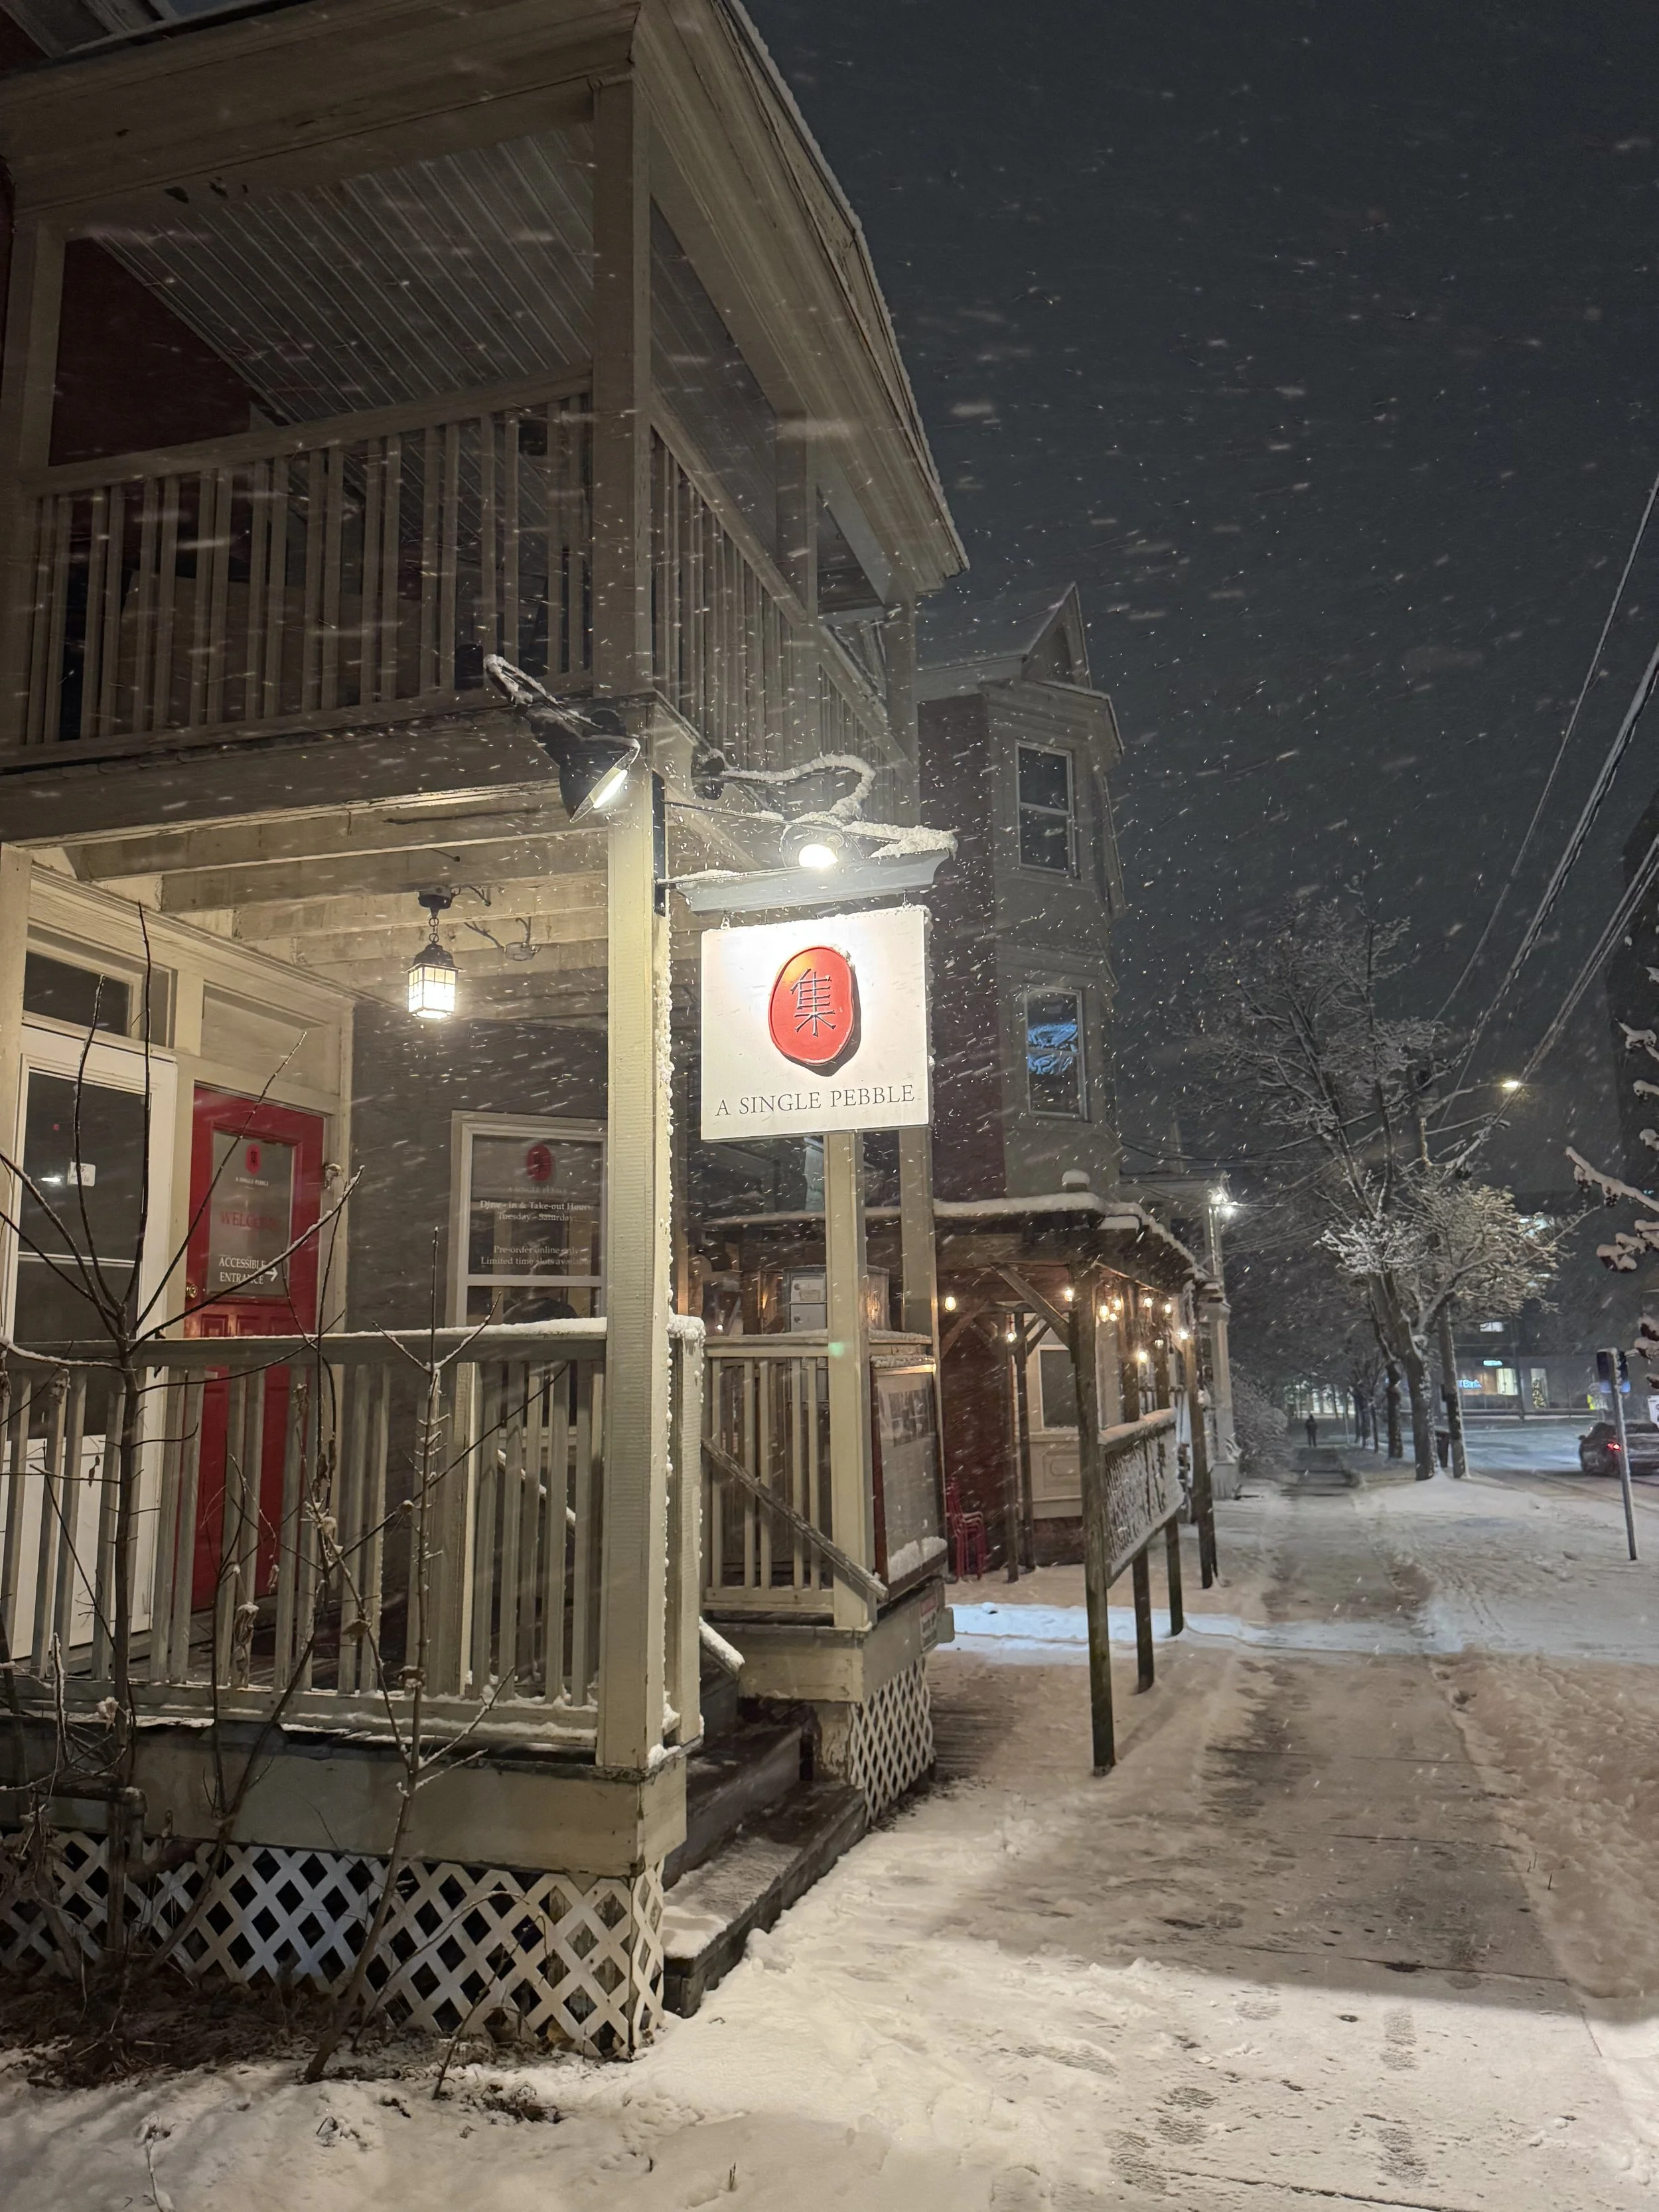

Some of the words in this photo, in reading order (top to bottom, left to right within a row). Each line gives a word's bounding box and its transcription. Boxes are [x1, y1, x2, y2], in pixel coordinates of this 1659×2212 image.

[790, 968, 836, 1037] 集
[715, 1098, 731, 1117] A
[739, 1092, 822, 1115] SINGLE
[830, 1084, 915, 1108] PEBBLE
[530, 1201, 565, 1210] Take-out
[498, 1210, 530, 1222] Tuesday
[538, 1213, 574, 1222] Saturday
[494, 1245, 532, 1254] Pre-order
[534, 1246, 561, 1254] online
[218, 1257, 266, 1270] ACCESSIBLE
[480, 1256, 514, 1265] Limited
[220, 1272, 264, 1285] ENTRACE
